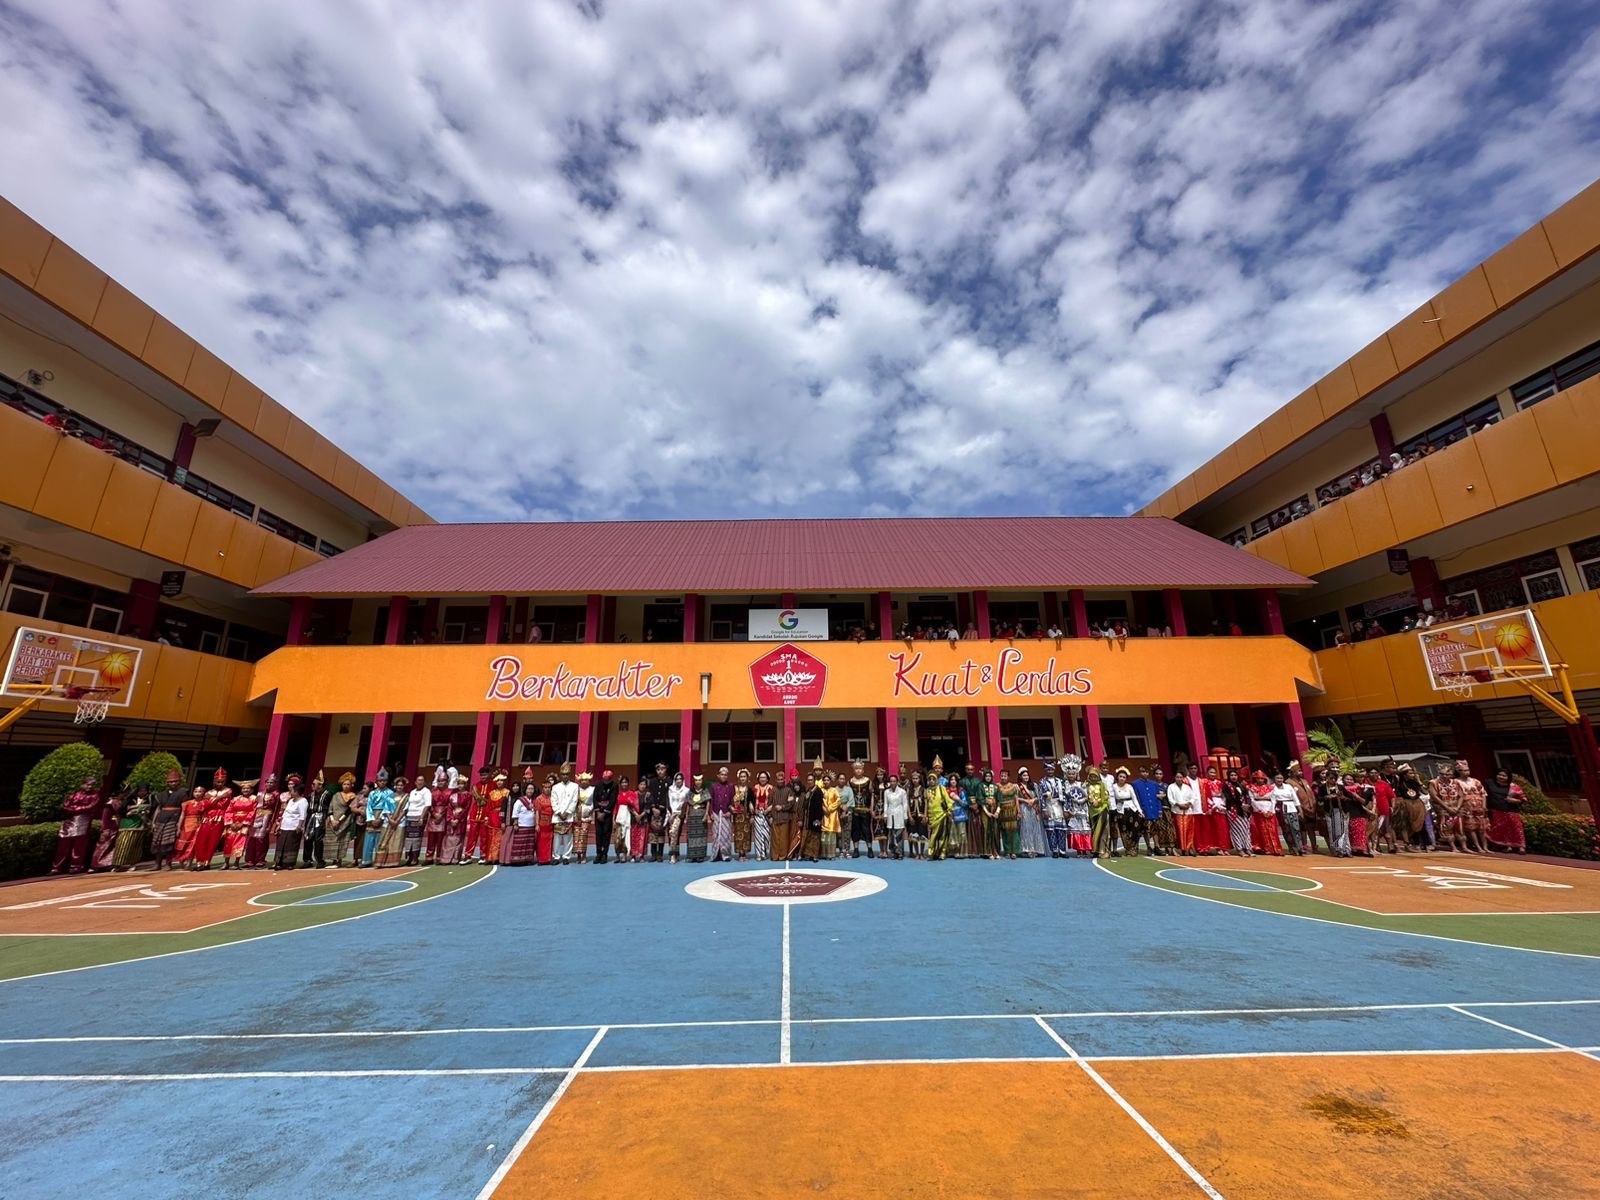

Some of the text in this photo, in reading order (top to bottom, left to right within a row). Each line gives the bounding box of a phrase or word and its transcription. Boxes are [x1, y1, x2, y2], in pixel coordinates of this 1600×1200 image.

[20, 645, 75, 661] BERKARAKTER
[16, 656, 55, 668] KUAT DAN
[786, 660, 792, 669] 1
[14, 666, 46, 677] CERDAS
[485, 655, 684, 701] Berkarakter
[888, 647, 1093, 697] Kuat & Cerdas
